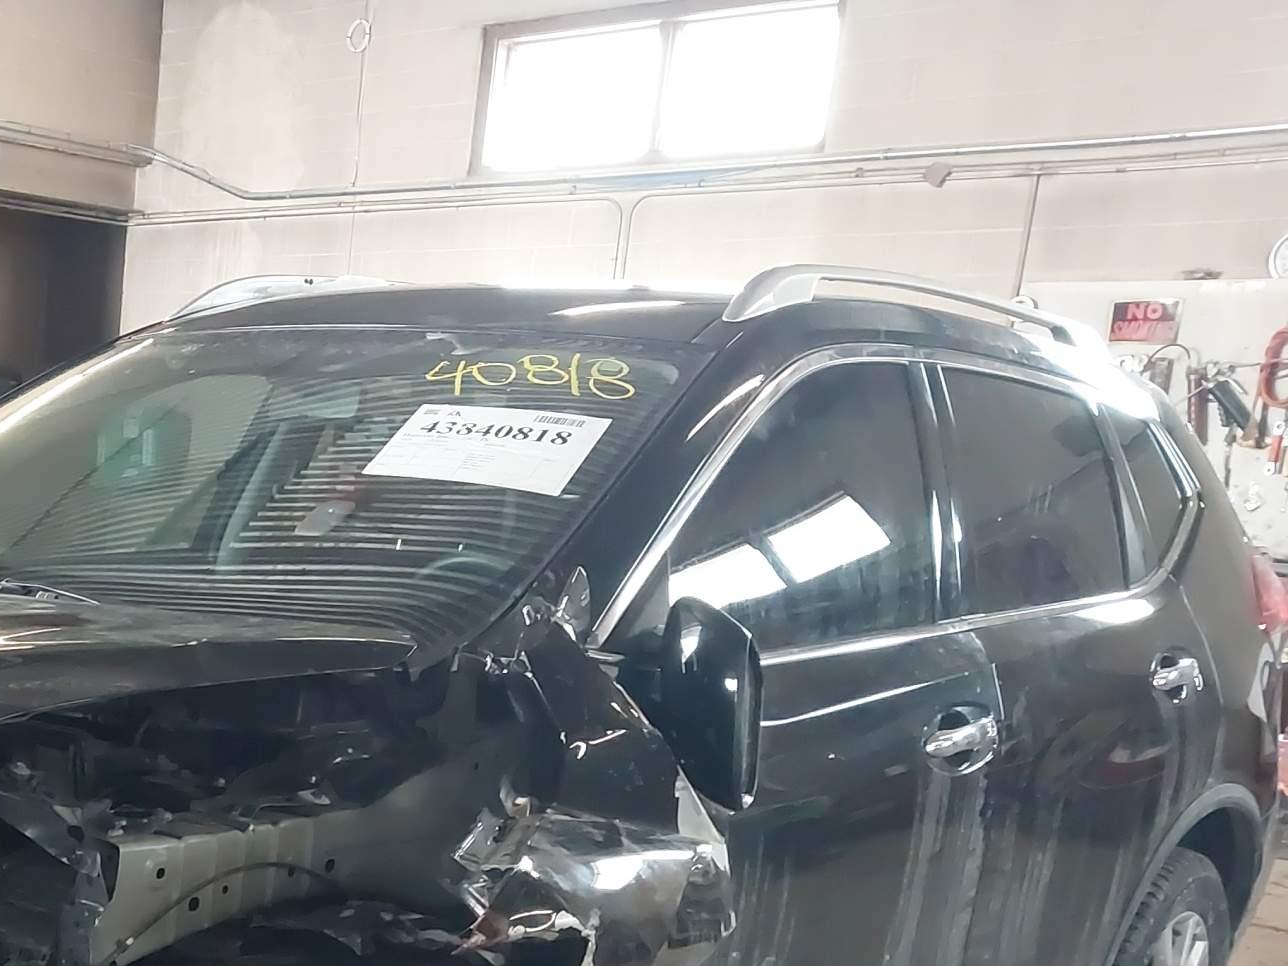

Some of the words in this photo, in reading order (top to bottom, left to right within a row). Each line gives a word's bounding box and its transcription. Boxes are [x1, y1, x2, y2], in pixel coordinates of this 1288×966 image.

[1127, 302, 1163, 320] NO
[425, 353, 637, 399] 40818
[420, 420, 573, 446] 43840818
